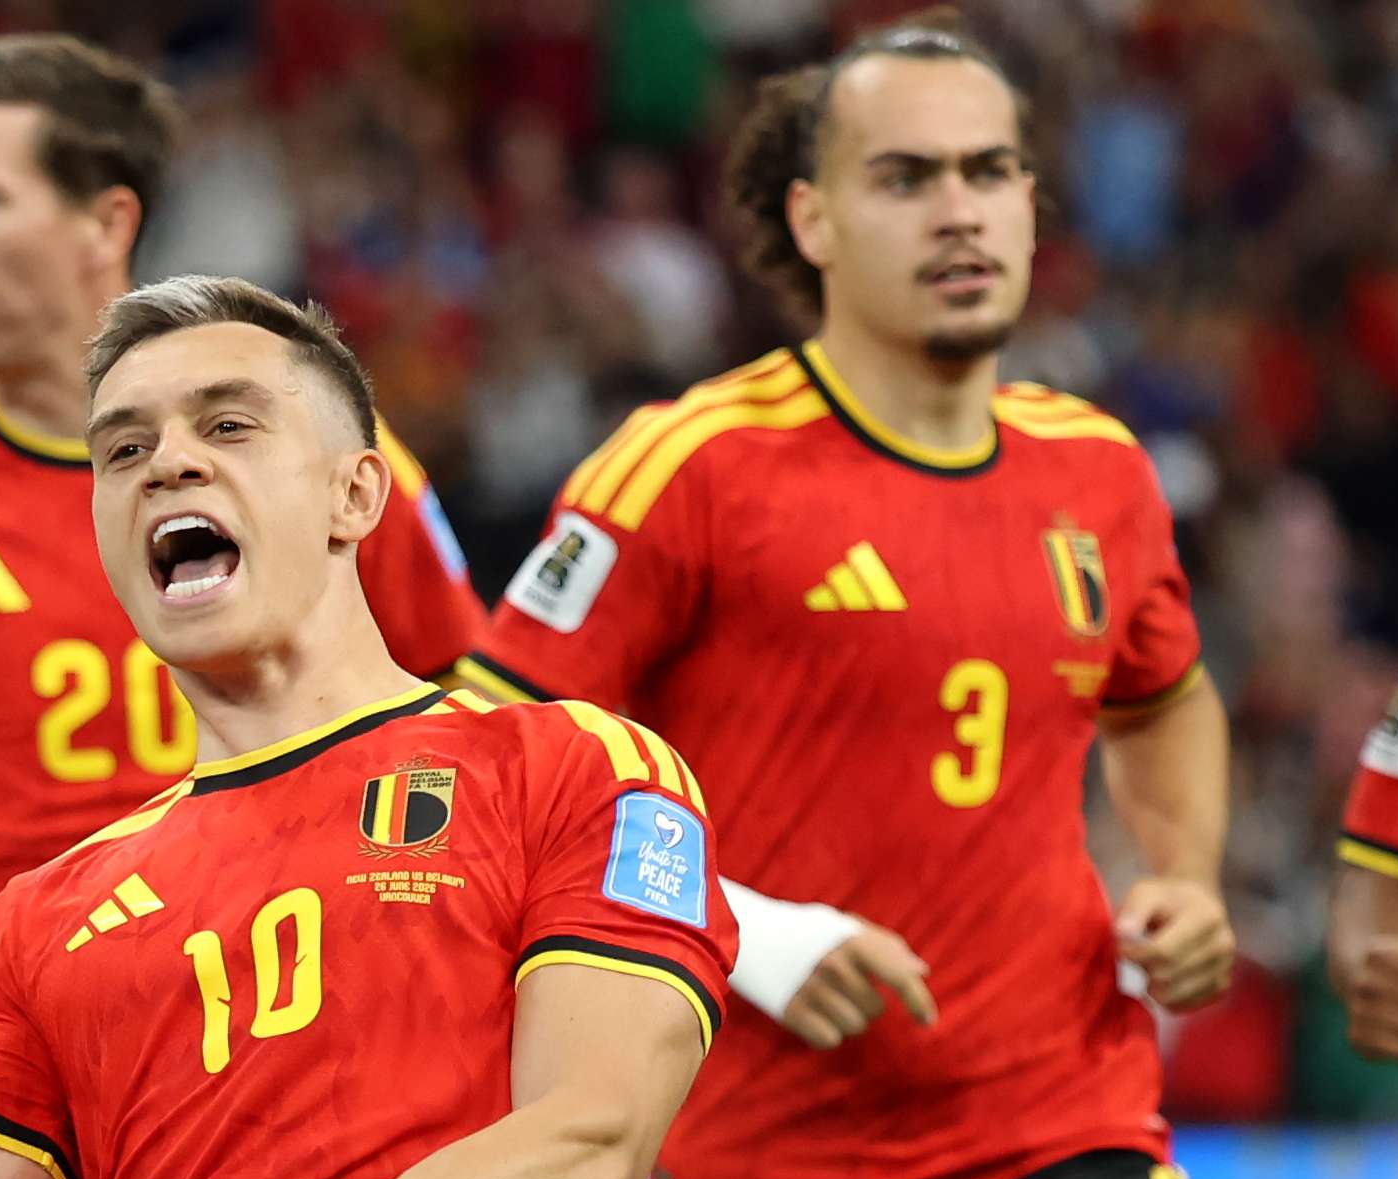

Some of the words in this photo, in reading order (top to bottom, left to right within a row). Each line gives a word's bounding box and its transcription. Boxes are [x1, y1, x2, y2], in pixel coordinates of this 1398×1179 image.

[31, 638, 198, 783] 20
[930, 657, 1010, 808] 3
[346, 873, 367, 885] NEW
[369, 871, 410, 882] ZEALAND
[425, 872, 465, 889] BELGIUM
[374, 882, 387, 892] 26
[389, 881, 411, 891] JUNE
[412, 882, 437, 893] 2026
[638, 862, 683, 898] PEACE
[379, 892, 431, 904] VANCOUVER
[644, 887, 670, 906] FIFA
[183, 887, 323, 1075] 10
